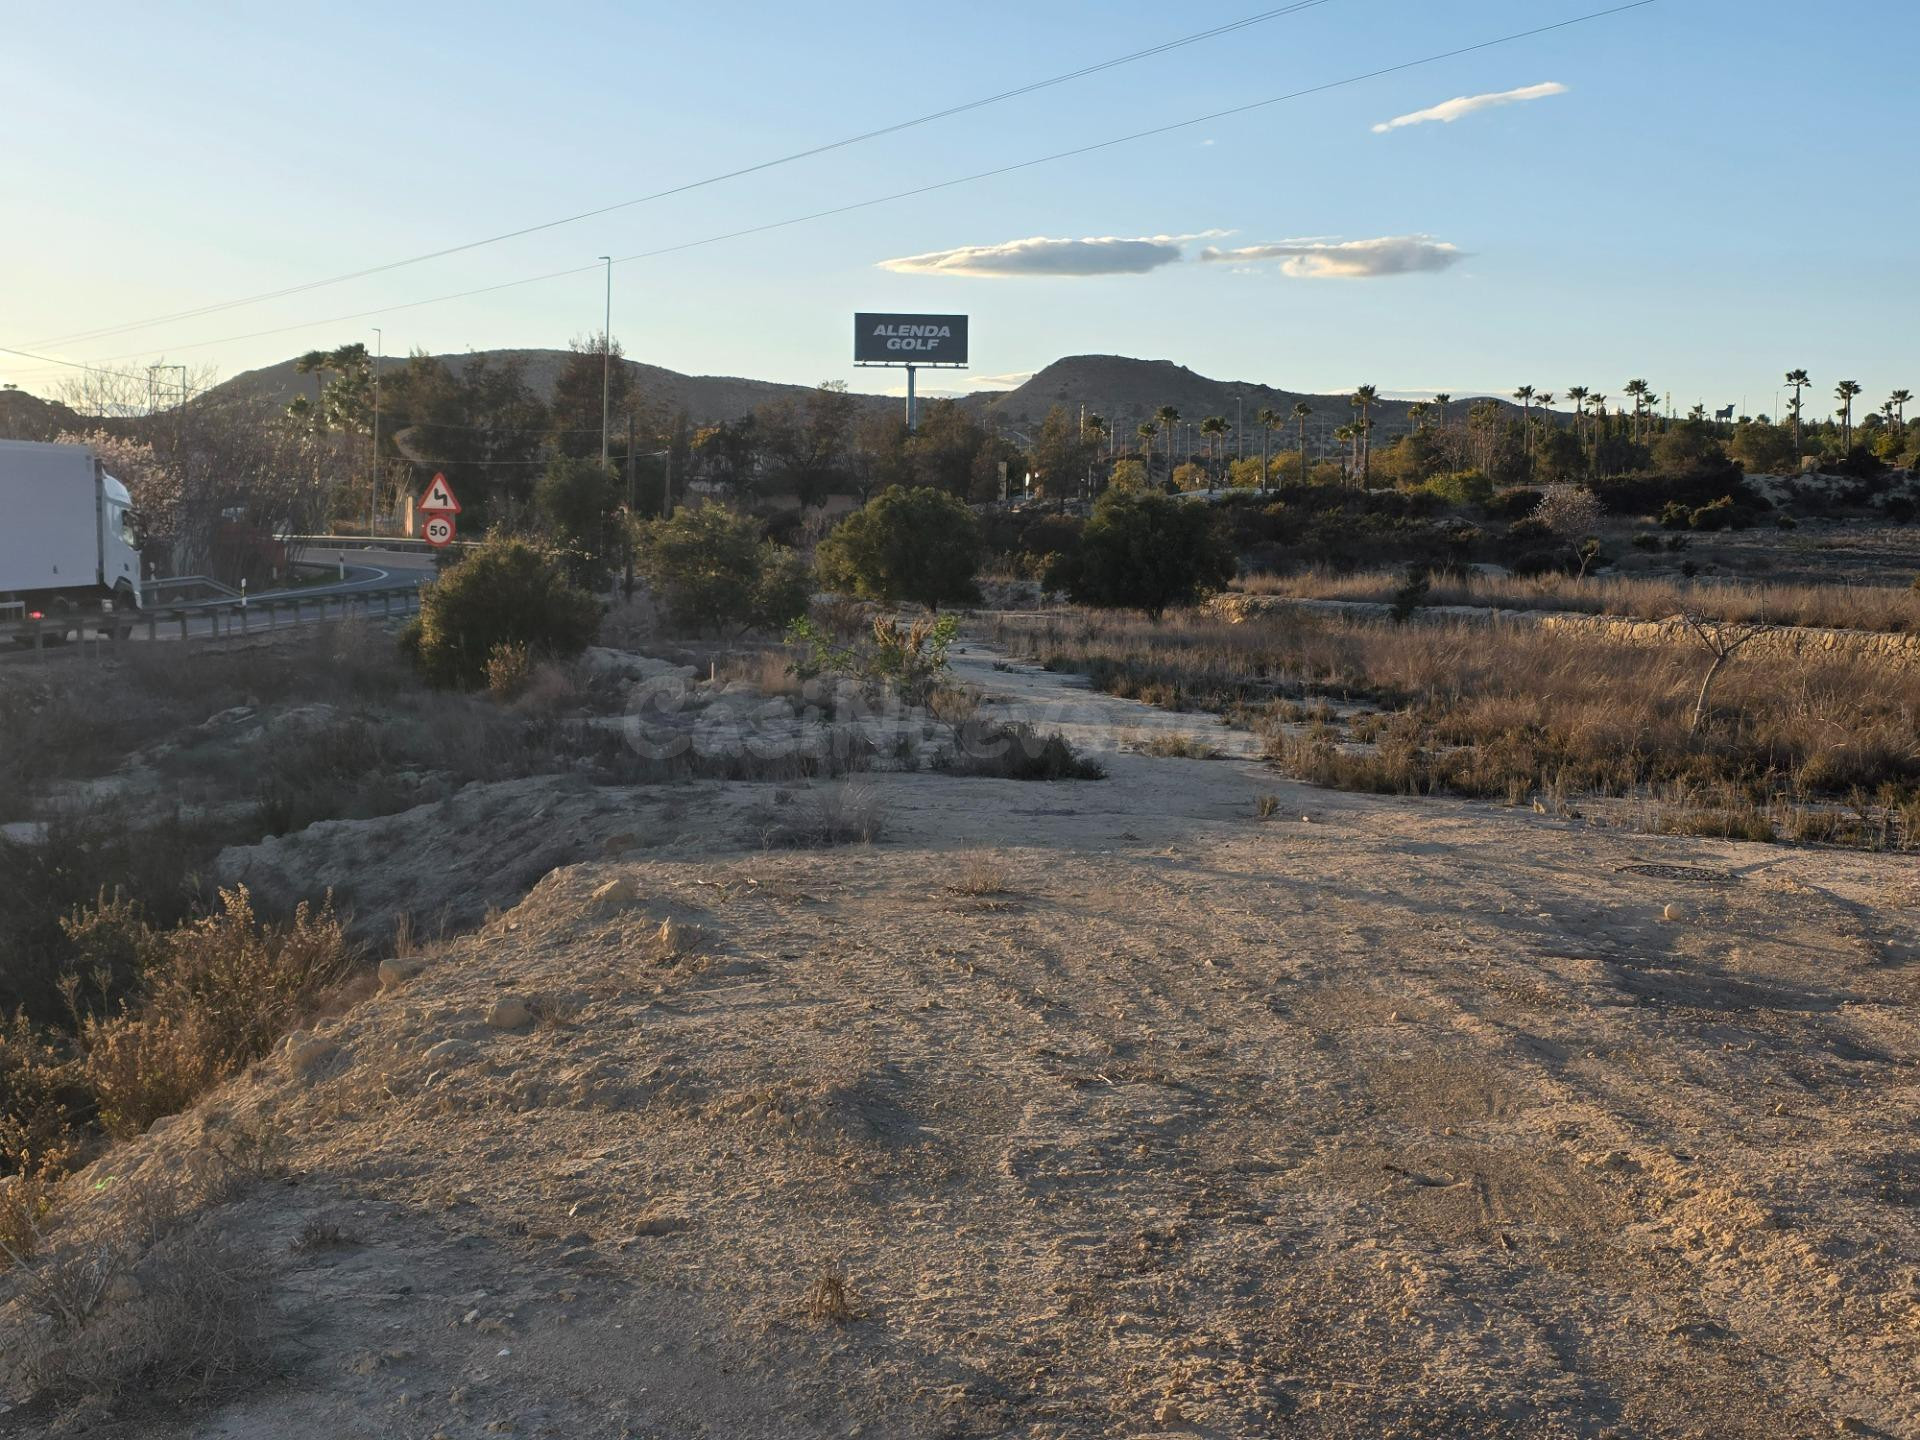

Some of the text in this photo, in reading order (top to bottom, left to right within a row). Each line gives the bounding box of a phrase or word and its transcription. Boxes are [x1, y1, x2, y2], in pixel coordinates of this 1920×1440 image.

[873, 324, 951, 337] ALENDA
[886, 338, 940, 350] GOLF
[430, 525, 448, 537] 50
